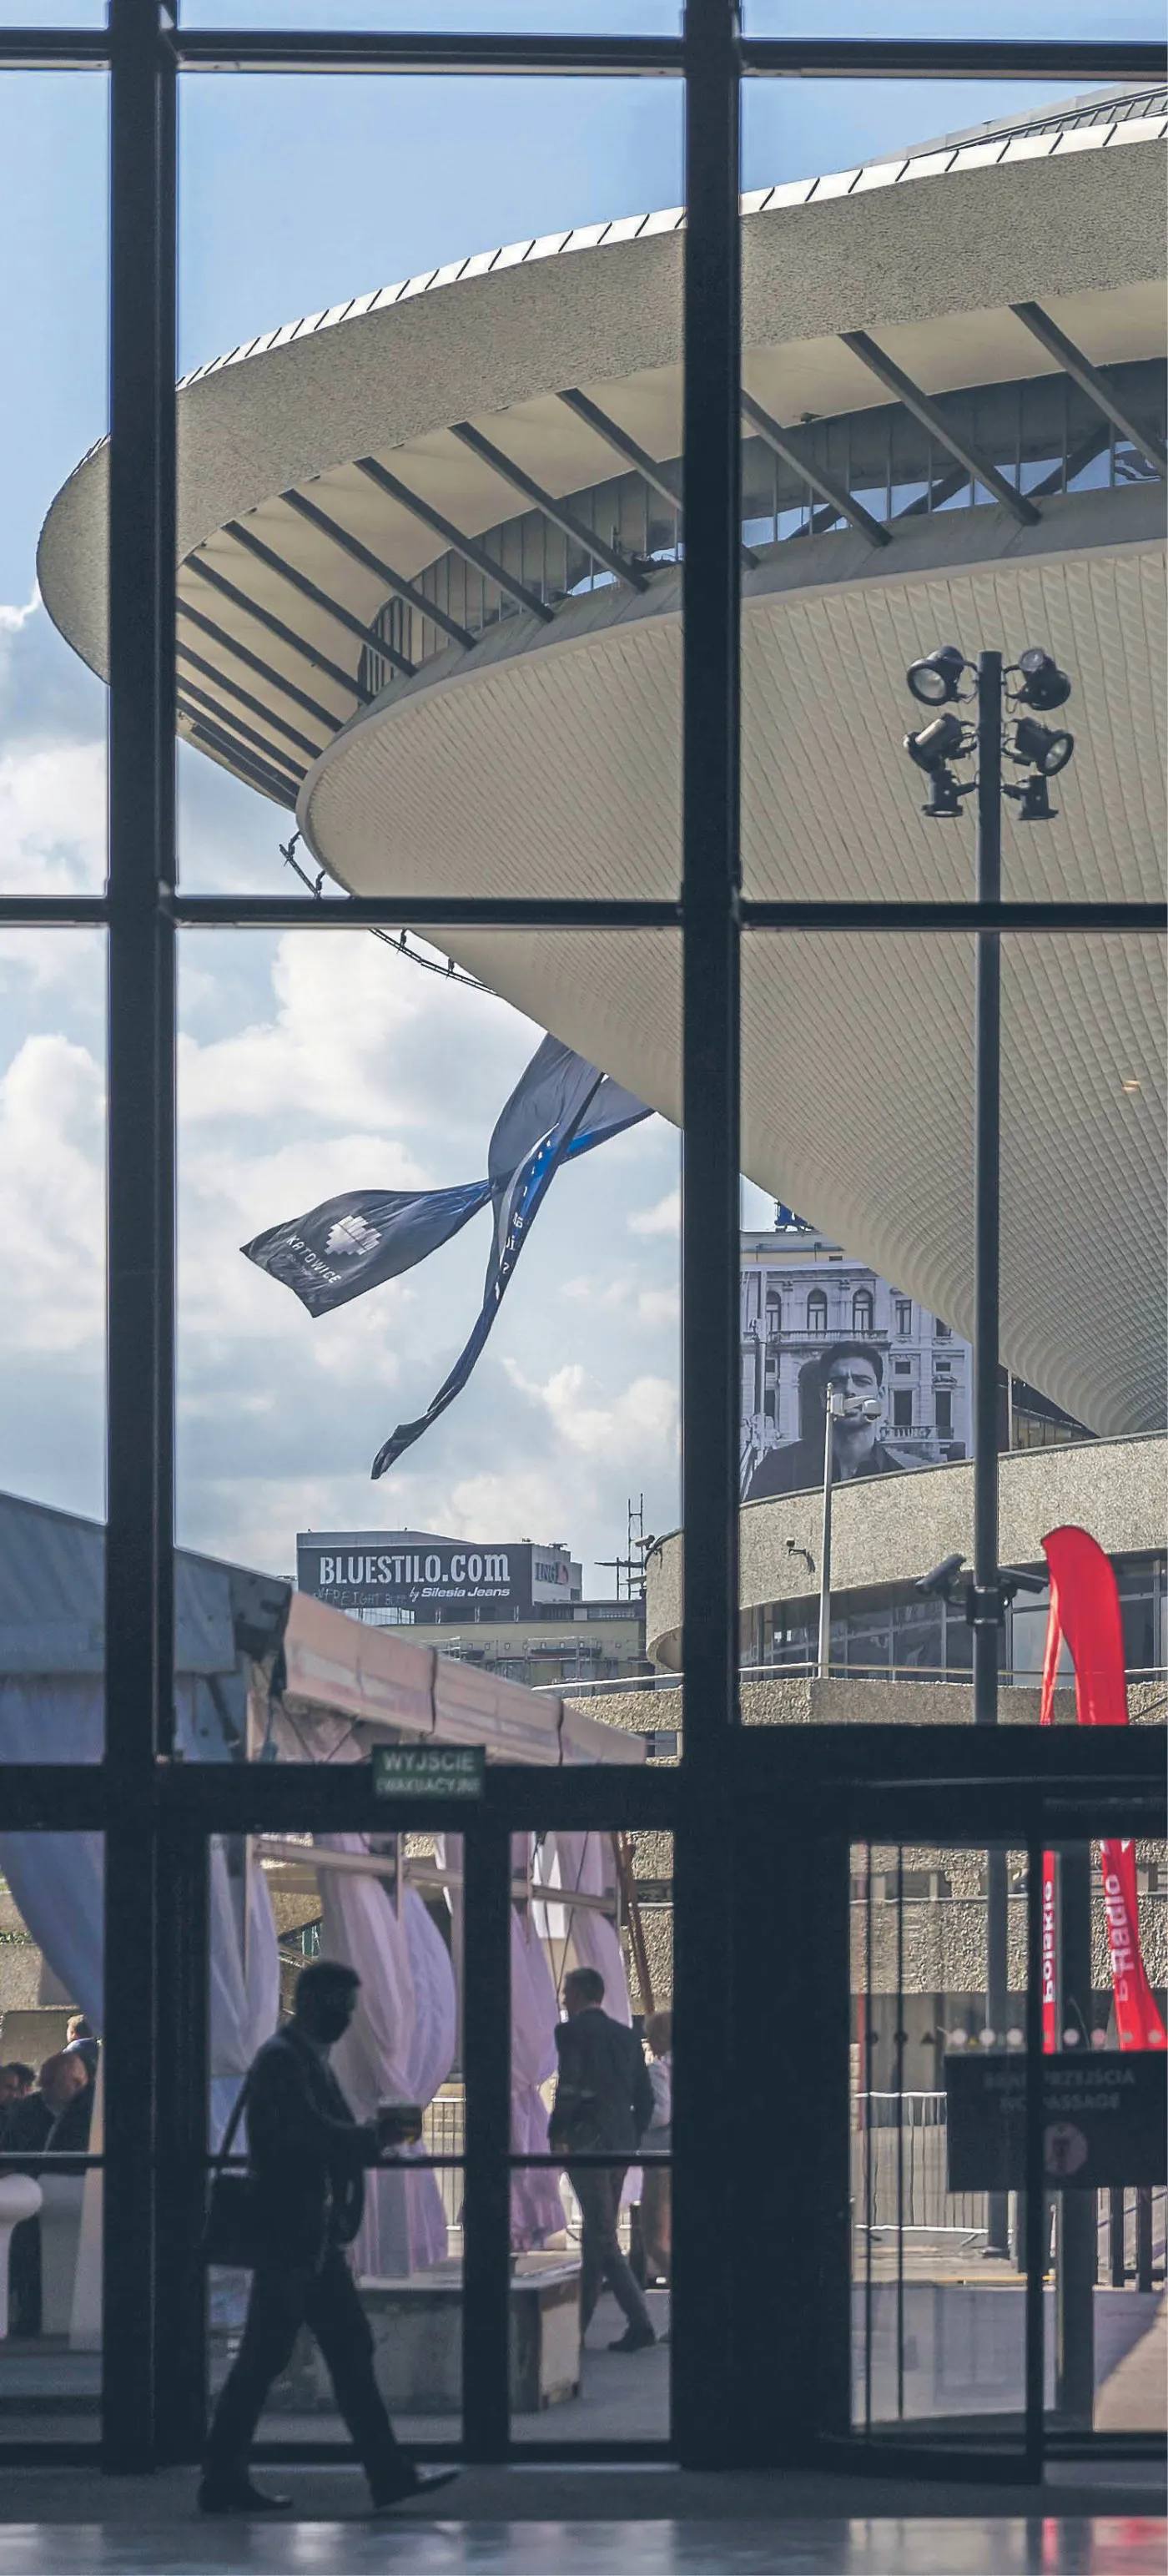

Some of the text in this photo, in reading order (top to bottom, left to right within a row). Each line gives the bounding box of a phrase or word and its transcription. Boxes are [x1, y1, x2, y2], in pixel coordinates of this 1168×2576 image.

[286, 1234, 342, 1283] KATOWICE
[410, 1586, 420, 1603] by
[421, 1587, 466, 1597] Silesia
[467, 1586, 511, 1597] Jeans
